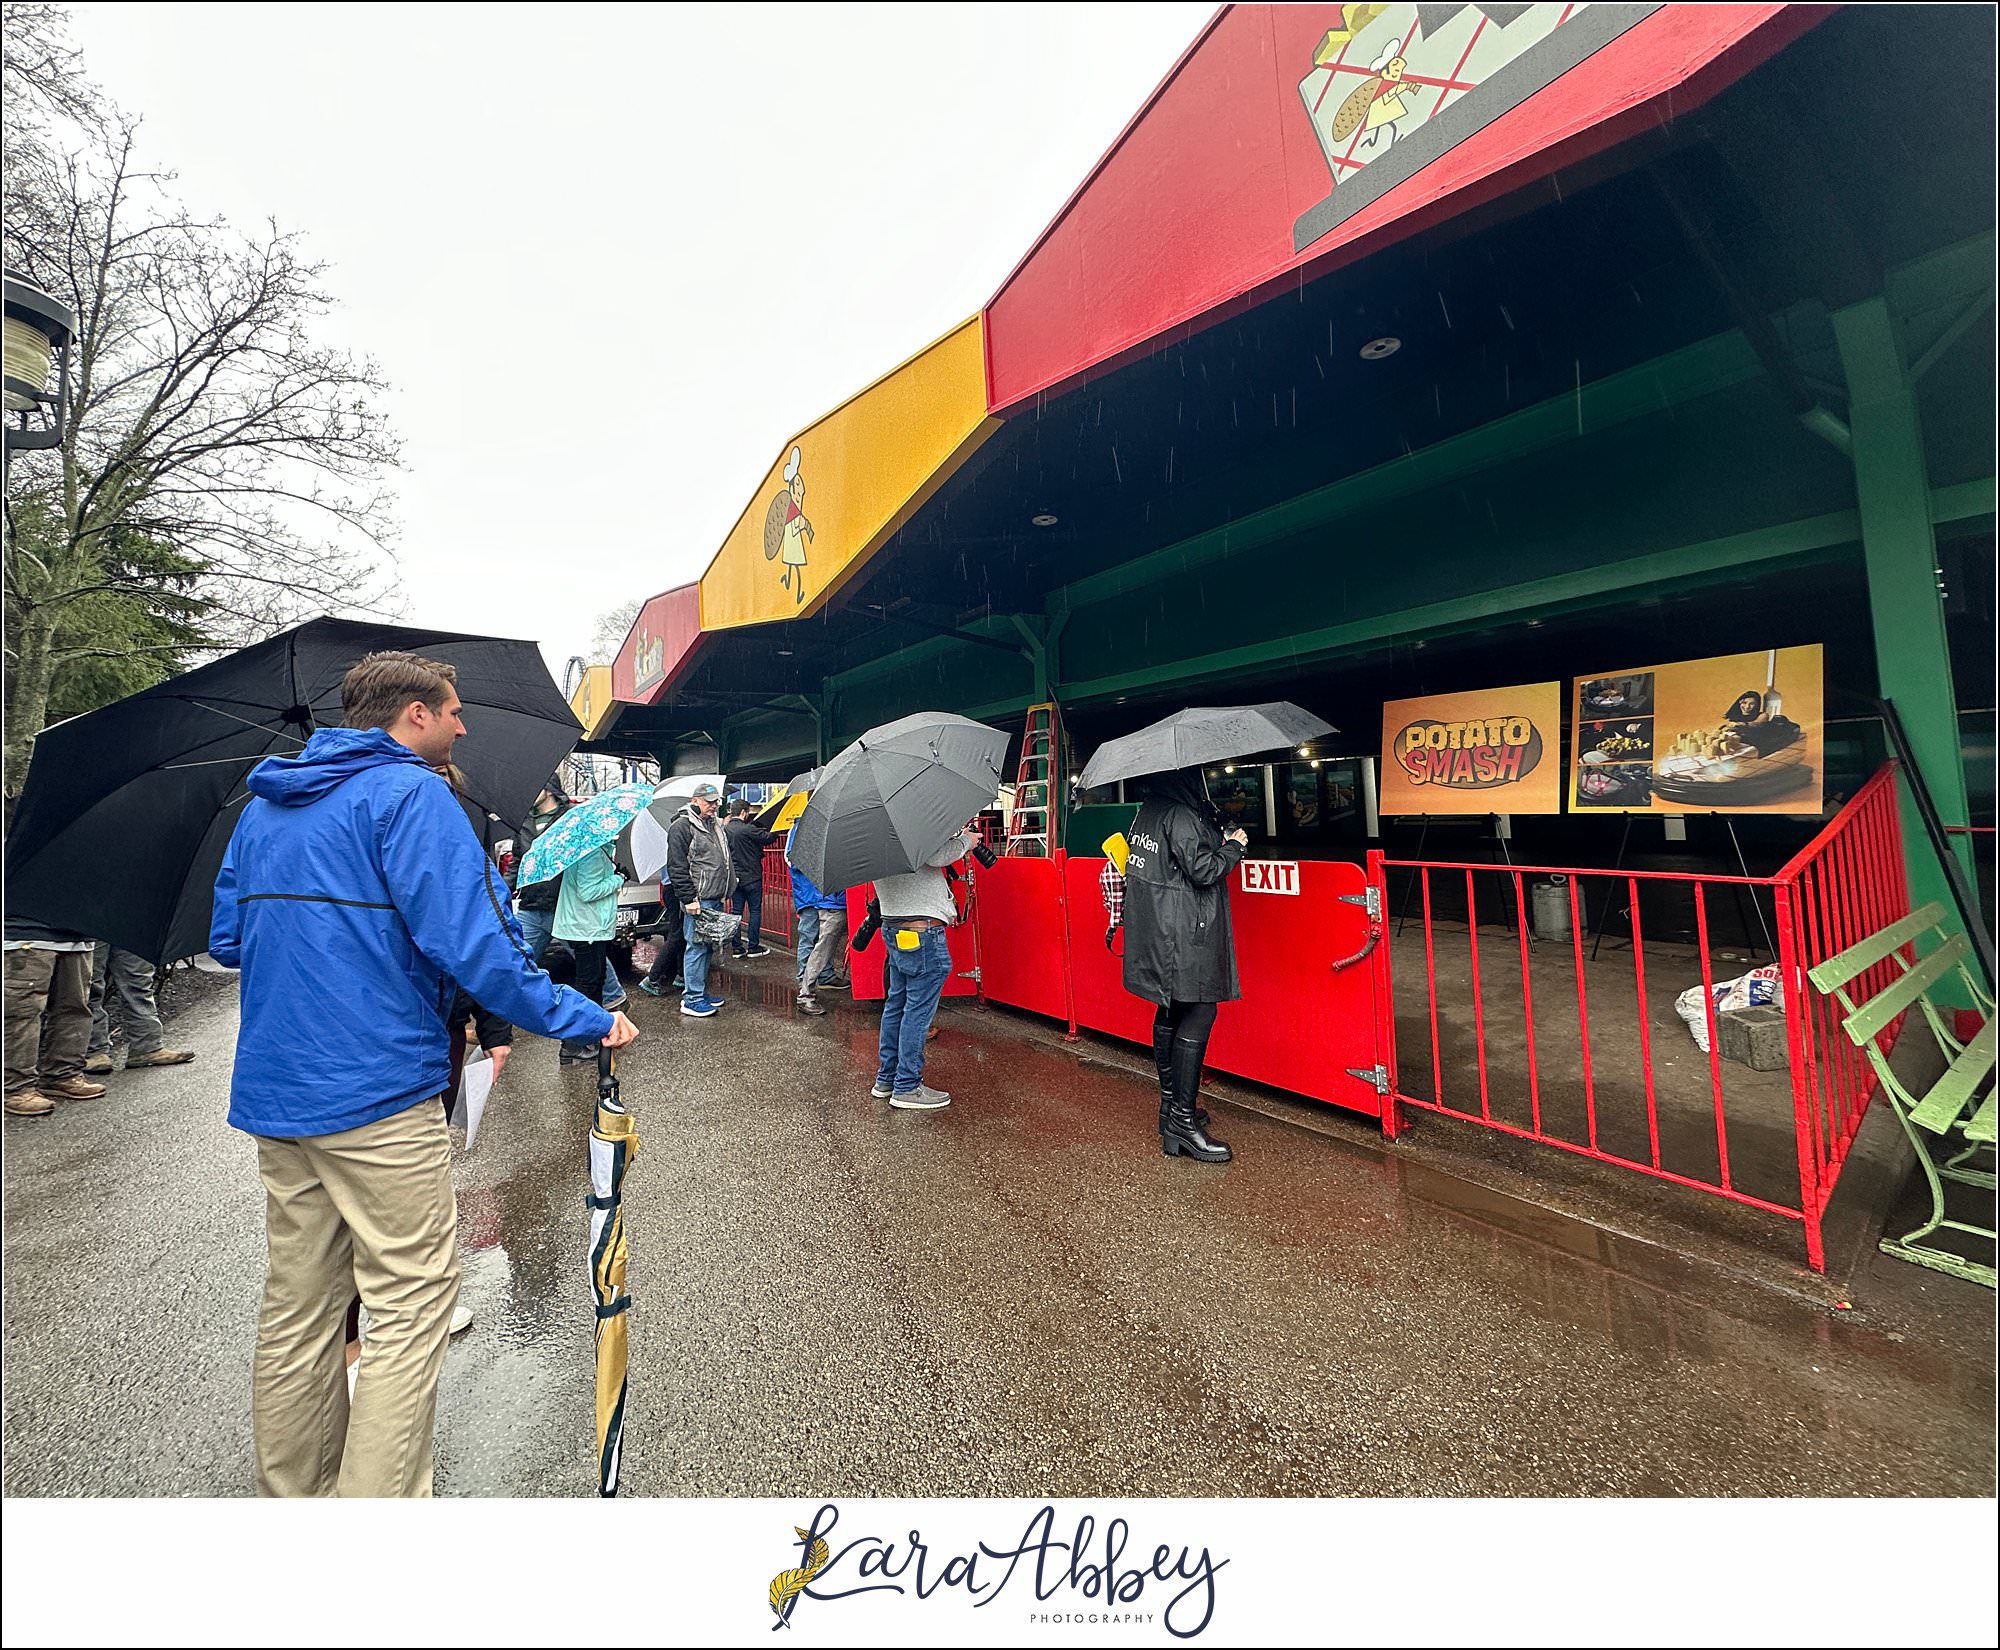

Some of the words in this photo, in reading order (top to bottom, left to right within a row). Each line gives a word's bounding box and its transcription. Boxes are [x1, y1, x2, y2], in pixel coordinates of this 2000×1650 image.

[1406, 716, 1531, 753] POTATO
[1405, 745, 1524, 785] SMASH
[1244, 863, 1295, 890] EXIT
